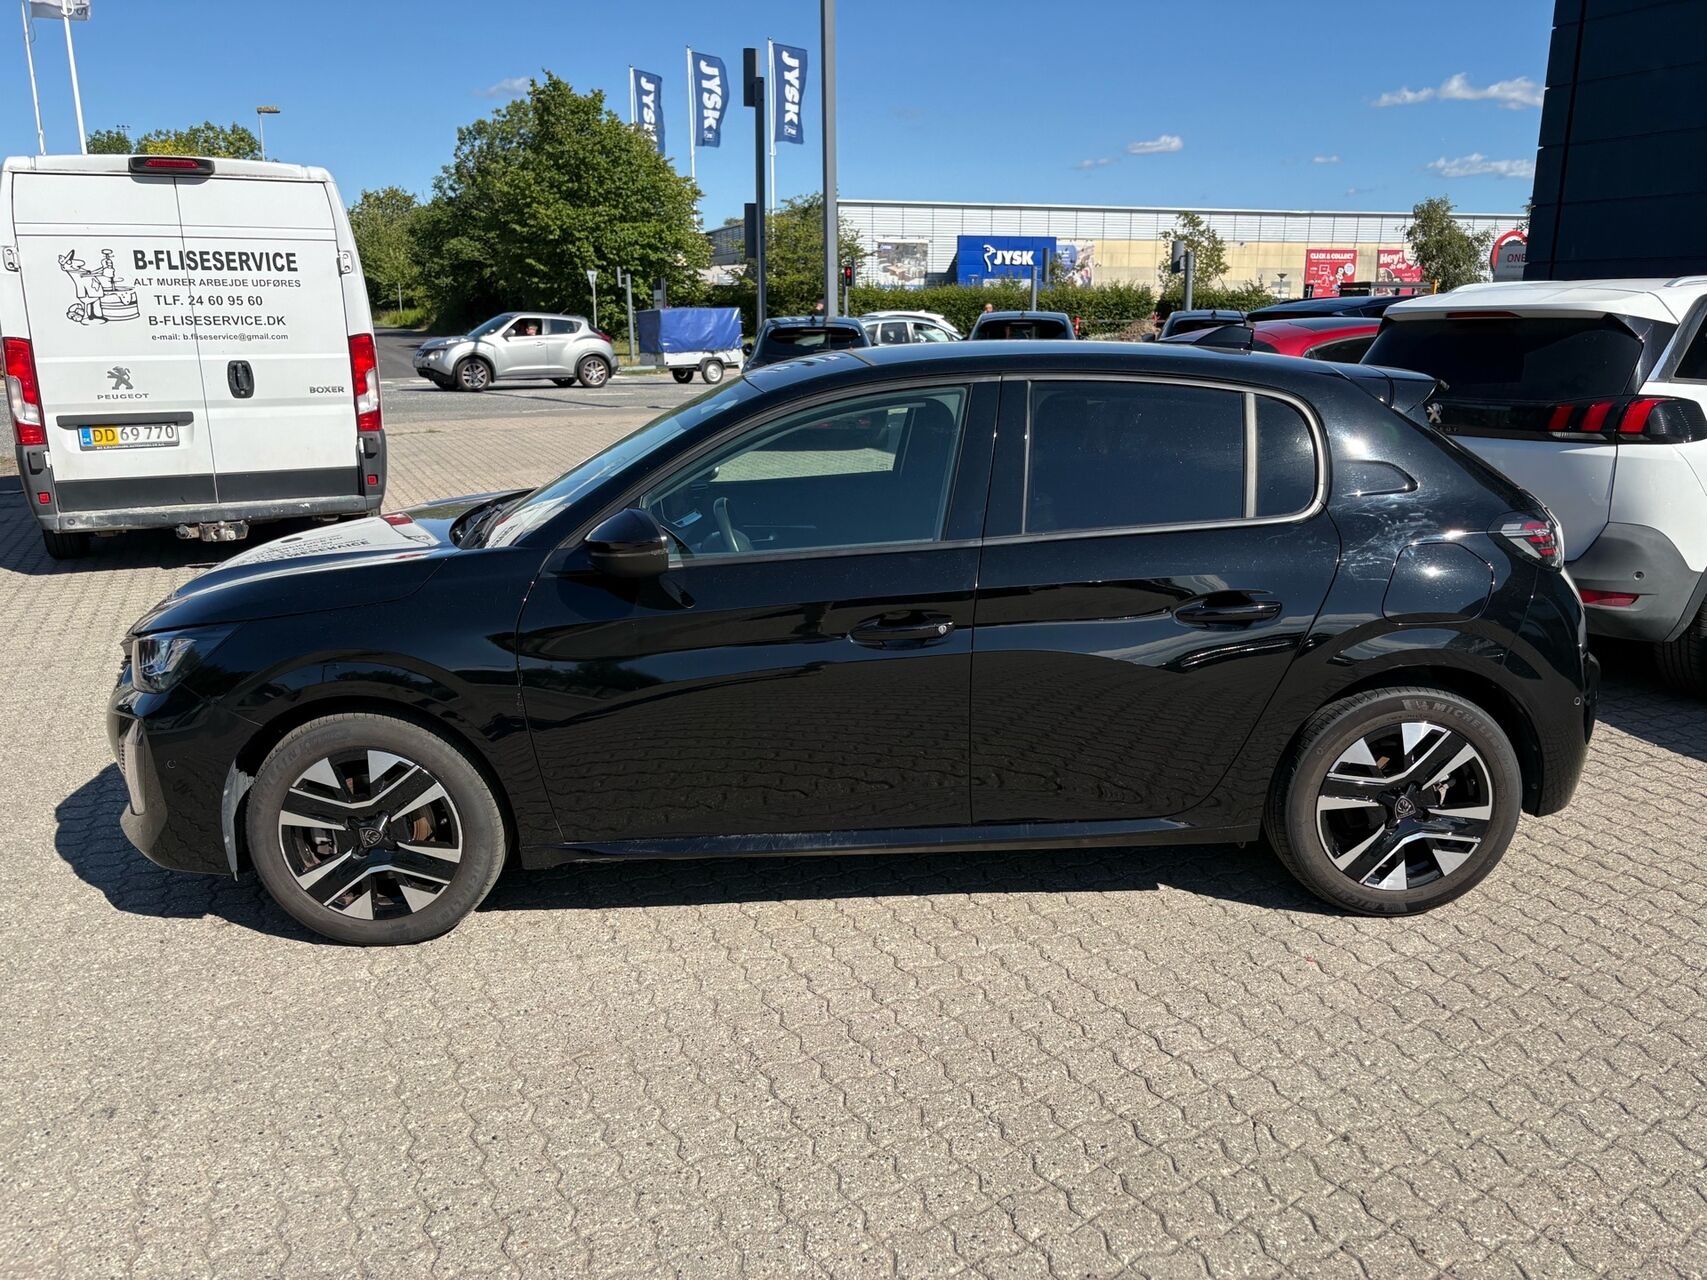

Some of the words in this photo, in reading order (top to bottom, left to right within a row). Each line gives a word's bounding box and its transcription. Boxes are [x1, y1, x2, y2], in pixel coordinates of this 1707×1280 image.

[700, 60, 722, 129] JYSK
[782, 50, 800, 125] JYSK
[133, 249, 298, 272] B-FLISESERVICE
[993, 250, 1034, 265] JYSK
[1379, 251, 1403, 265] Hey!
[133, 278, 153, 286] ALT
[156, 278, 196, 287] MURER
[198, 278, 249, 288] ARBEJDE
[251, 279, 301, 288] UDFØRES
[153, 294, 184, 306] TLF.
[187, 295, 204, 306] 24
[207, 295, 224, 306] 60
[227, 295, 244, 306] 95
[247, 295, 263, 306] 60
[148, 315, 286, 326] B-FLISESERVICE.DK
[151, 333, 181, 341] e-mail:
[182, 333, 289, 342] b.fliseservice@gmail.com
[92, 429, 116, 443] DD
[120, 427, 141, 441] 69
[143, 425, 175, 440] 770
